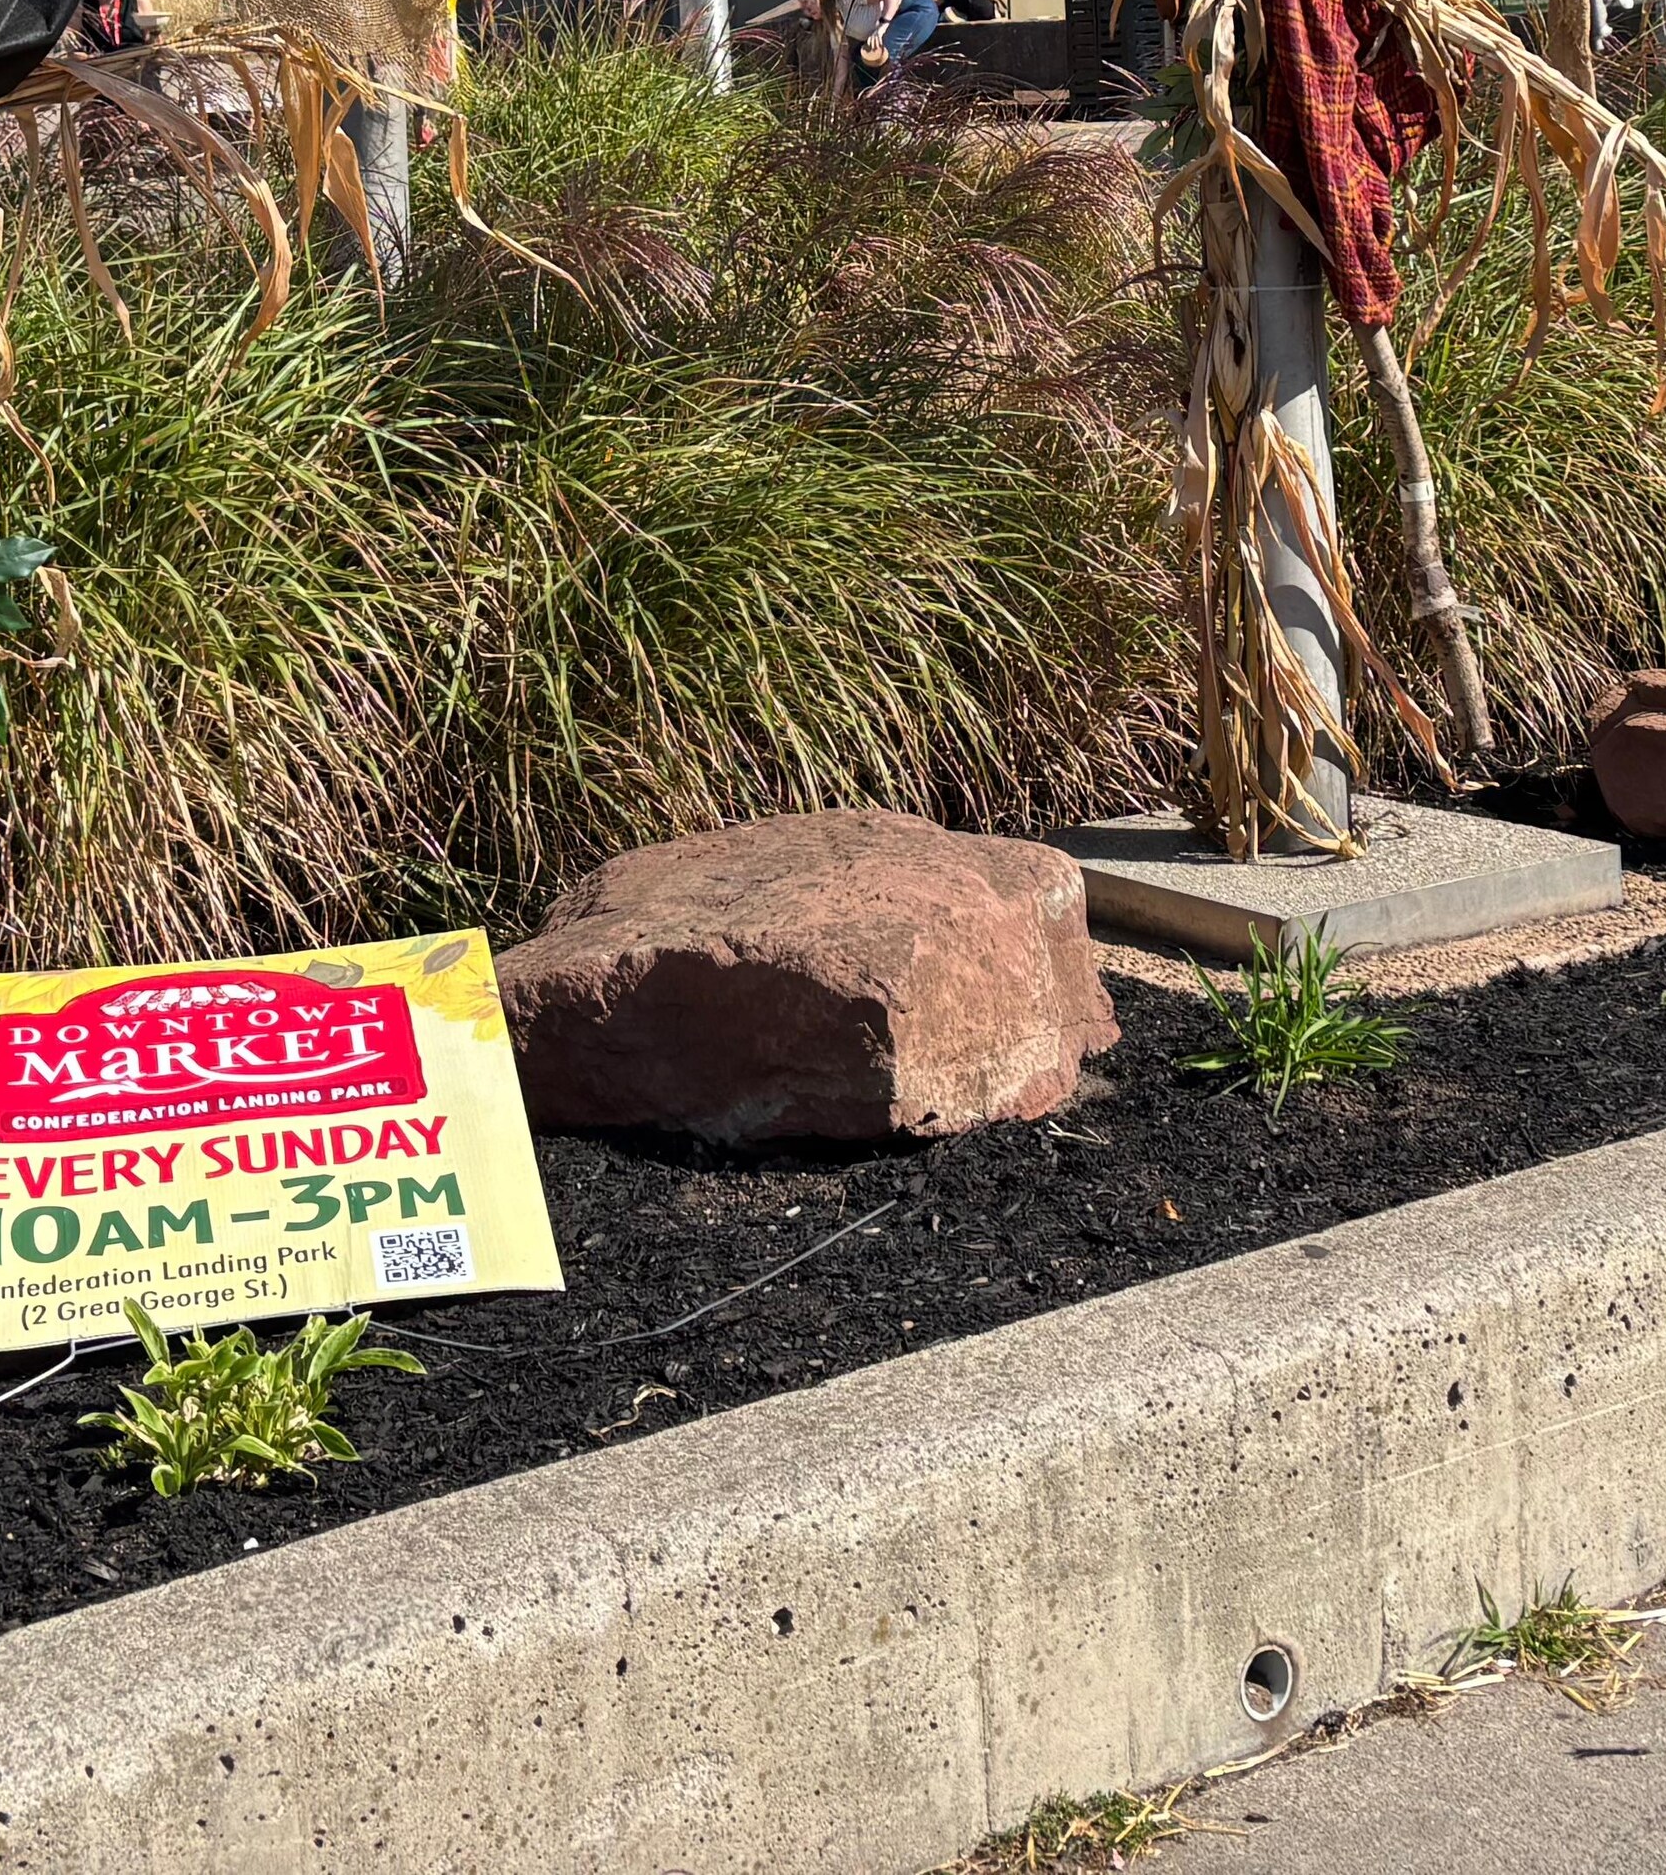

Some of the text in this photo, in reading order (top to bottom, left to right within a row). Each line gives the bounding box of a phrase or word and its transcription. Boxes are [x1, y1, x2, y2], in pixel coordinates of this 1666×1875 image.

[8, 997, 382, 1046] DOWNTOWN
[11, 1081, 393, 1131] CONFEDERATION LANDING PARK
[201, 1116, 449, 1179] SUNDAY
[162, 1251, 268, 1281] Landing
[278, 1240, 339, 1267] Park
[20, 1273, 289, 1331] (2 Grea George St.)
